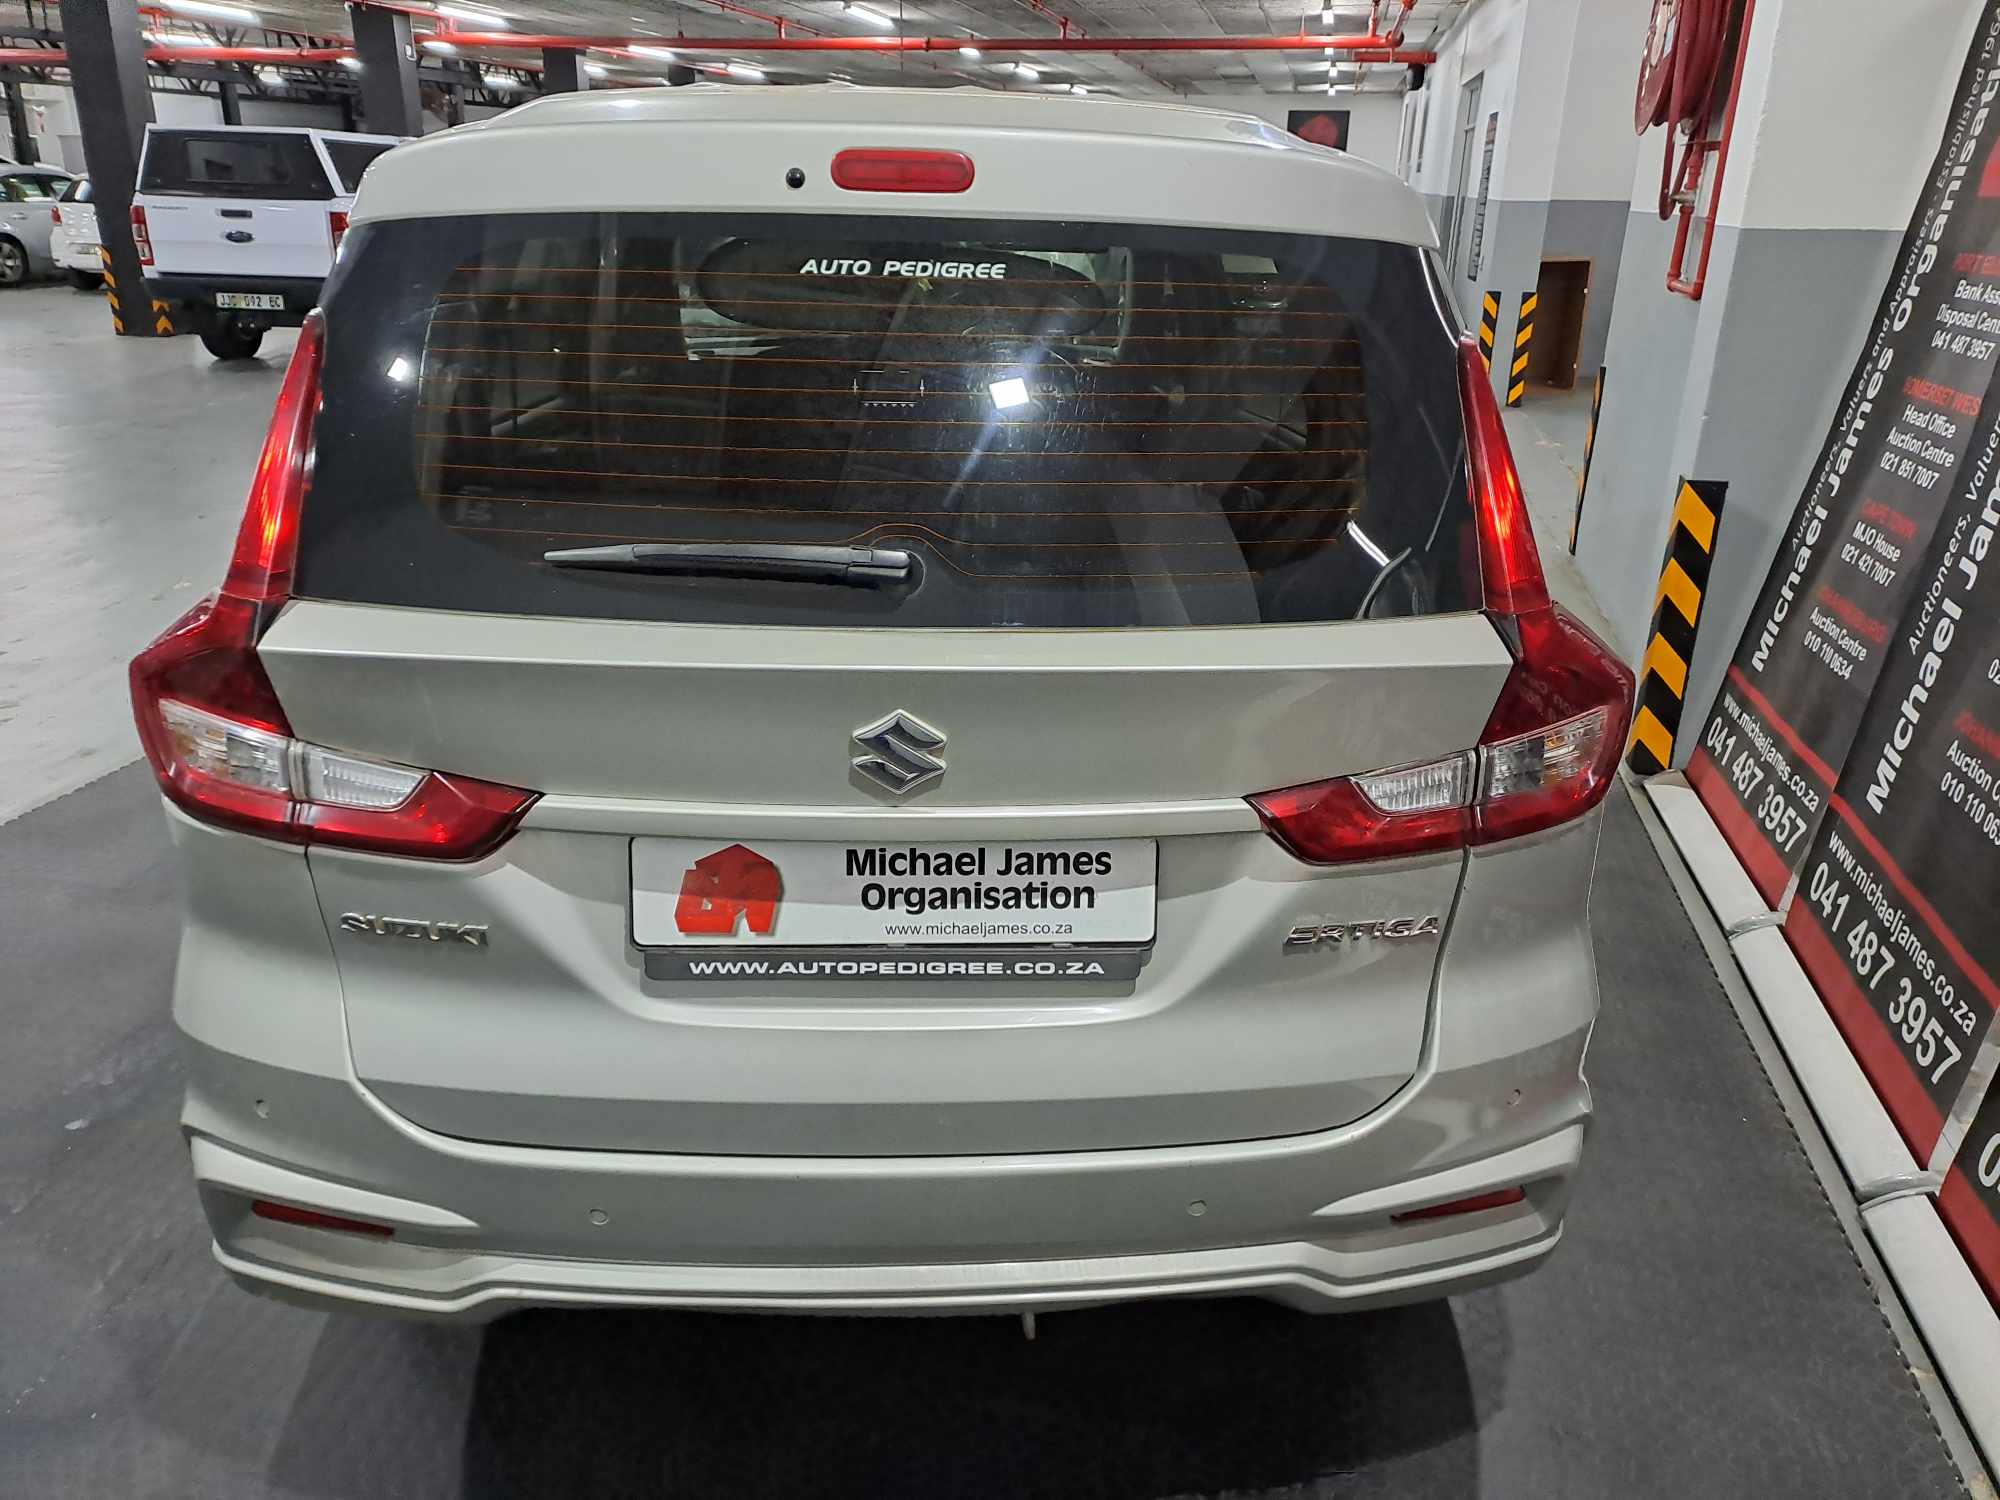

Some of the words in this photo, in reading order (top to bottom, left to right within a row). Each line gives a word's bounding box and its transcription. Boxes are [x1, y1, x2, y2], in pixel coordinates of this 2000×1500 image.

[1872, 318, 1890, 357] and
[1890, 208, 1935, 315] Appraisers
[1936, 68, 1985, 189] Established
[800, 258, 871, 277] AUTO
[883, 260, 1006, 280] PEDIGREE
[1954, 279, 1984, 302] Bank
[1936, 304, 1980, 328] Disposal
[1931, 330, 1952, 350] 041
[1950, 334, 1969, 355] 487
[1966, 338, 1996, 360] 3957
[1902, 404, 1931, 428] Head
[1928, 412, 1956, 438] Office
[1886, 426, 1921, 454] Auction
[1920, 440, 1955, 467] Centre
[1880, 451, 1900, 472] 021
[1897, 458, 1917, 479] 851
[1912, 465, 1940, 490] 7007
[1752, 505, 1828, 673] Michael
[1827, 347, 1894, 497] James
[1852, 521, 1876, 546] MJO
[1873, 532, 1901, 562] House
[1841, 543, 1860, 564] 021
[1858, 552, 1874, 575] 421
[1870, 561, 1897, 587] 7007
[1907, 512, 1971, 655] Auctioneers,
[1810, 606, 1841, 641] Auction
[1837, 629, 1867, 662] Centre
[1804, 630, 1821, 653] 010
[1819, 642, 1835, 664] 110
[1829, 652, 1854, 680] 0634
[1866, 597, 1963, 815] Michael
[1723, 692, 1820, 814] www.michaeljames.co.za
[1946, 739, 1993, 792] Auction
[1706, 716, 1737, 766] 041
[1731, 750, 1765, 799] 487
[1757, 783, 1808, 853] 3957
[1940, 771, 1965, 803] 010
[1964, 792, 1986, 824] 110
[845, 847, 986, 877] Michael
[995, 848, 1112, 876] James
[861, 881, 1095, 915] Organisation
[340, 911, 489, 947] SUZUKI
[885, 921, 1073, 938] www.michaeljames.co.za
[1284, 914, 1440, 946] ERTIGA
[1829, 830, 1977, 1037] www.michaeljames.co.za
[689, 960, 1105, 977] WWW.AUTOPEDIGREE.CO.ZA
[1809, 862, 1850, 933] 041
[1847, 919, 1896, 990] 487
[1888, 976, 1963, 1085] 3957
